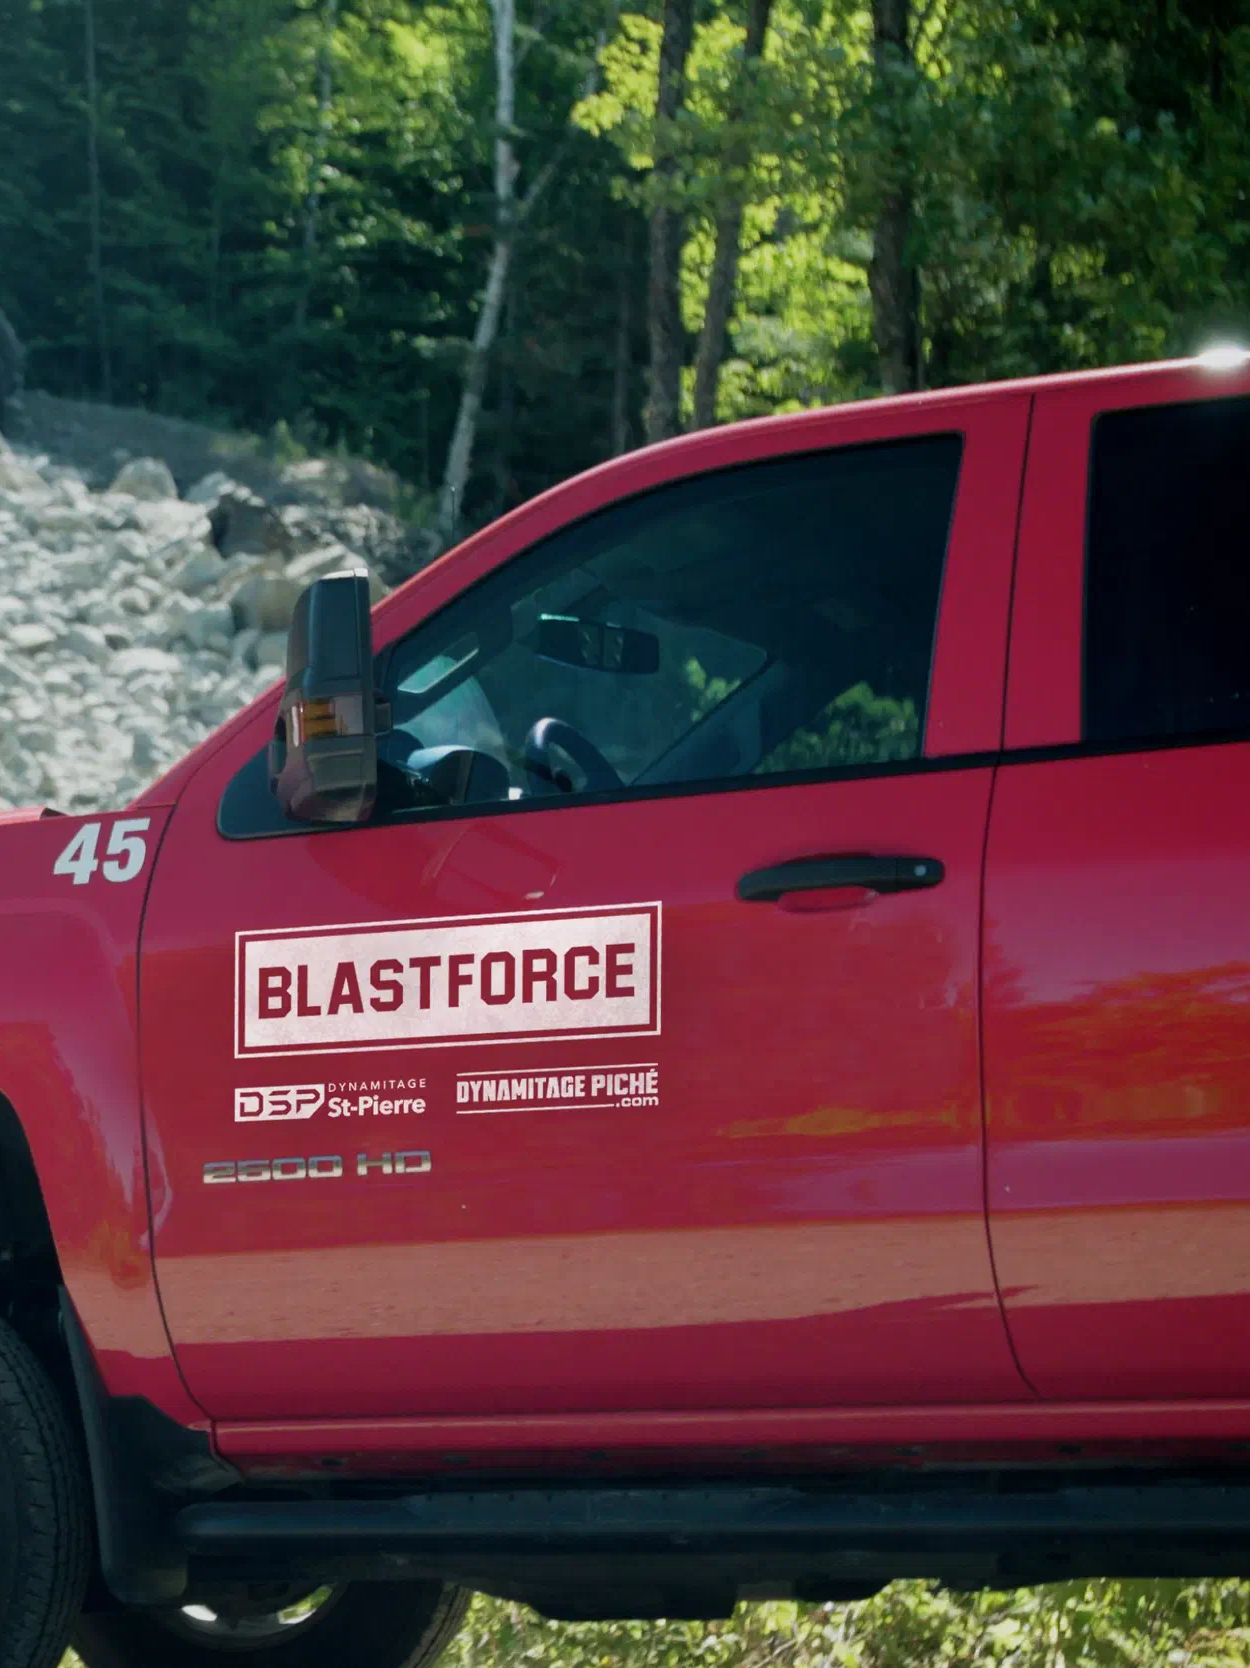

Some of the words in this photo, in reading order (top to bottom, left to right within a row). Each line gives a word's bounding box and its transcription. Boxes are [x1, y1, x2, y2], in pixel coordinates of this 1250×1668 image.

[53, 818, 151, 885] 45
[258, 942, 636, 1020] BLASTFORCE
[328, 1078, 427, 1093] DYNAMITAGE
[456, 1075, 586, 1103] DYNAMITAGE
[591, 1068, 659, 1097] PICHÉ
[239, 1088, 321, 1118] DSP
[327, 1095, 427, 1118] St-Pierre
[615, 1096, 660, 1108] .com
[203, 1155, 344, 1184] 2500
[357, 1150, 432, 1176] HD
